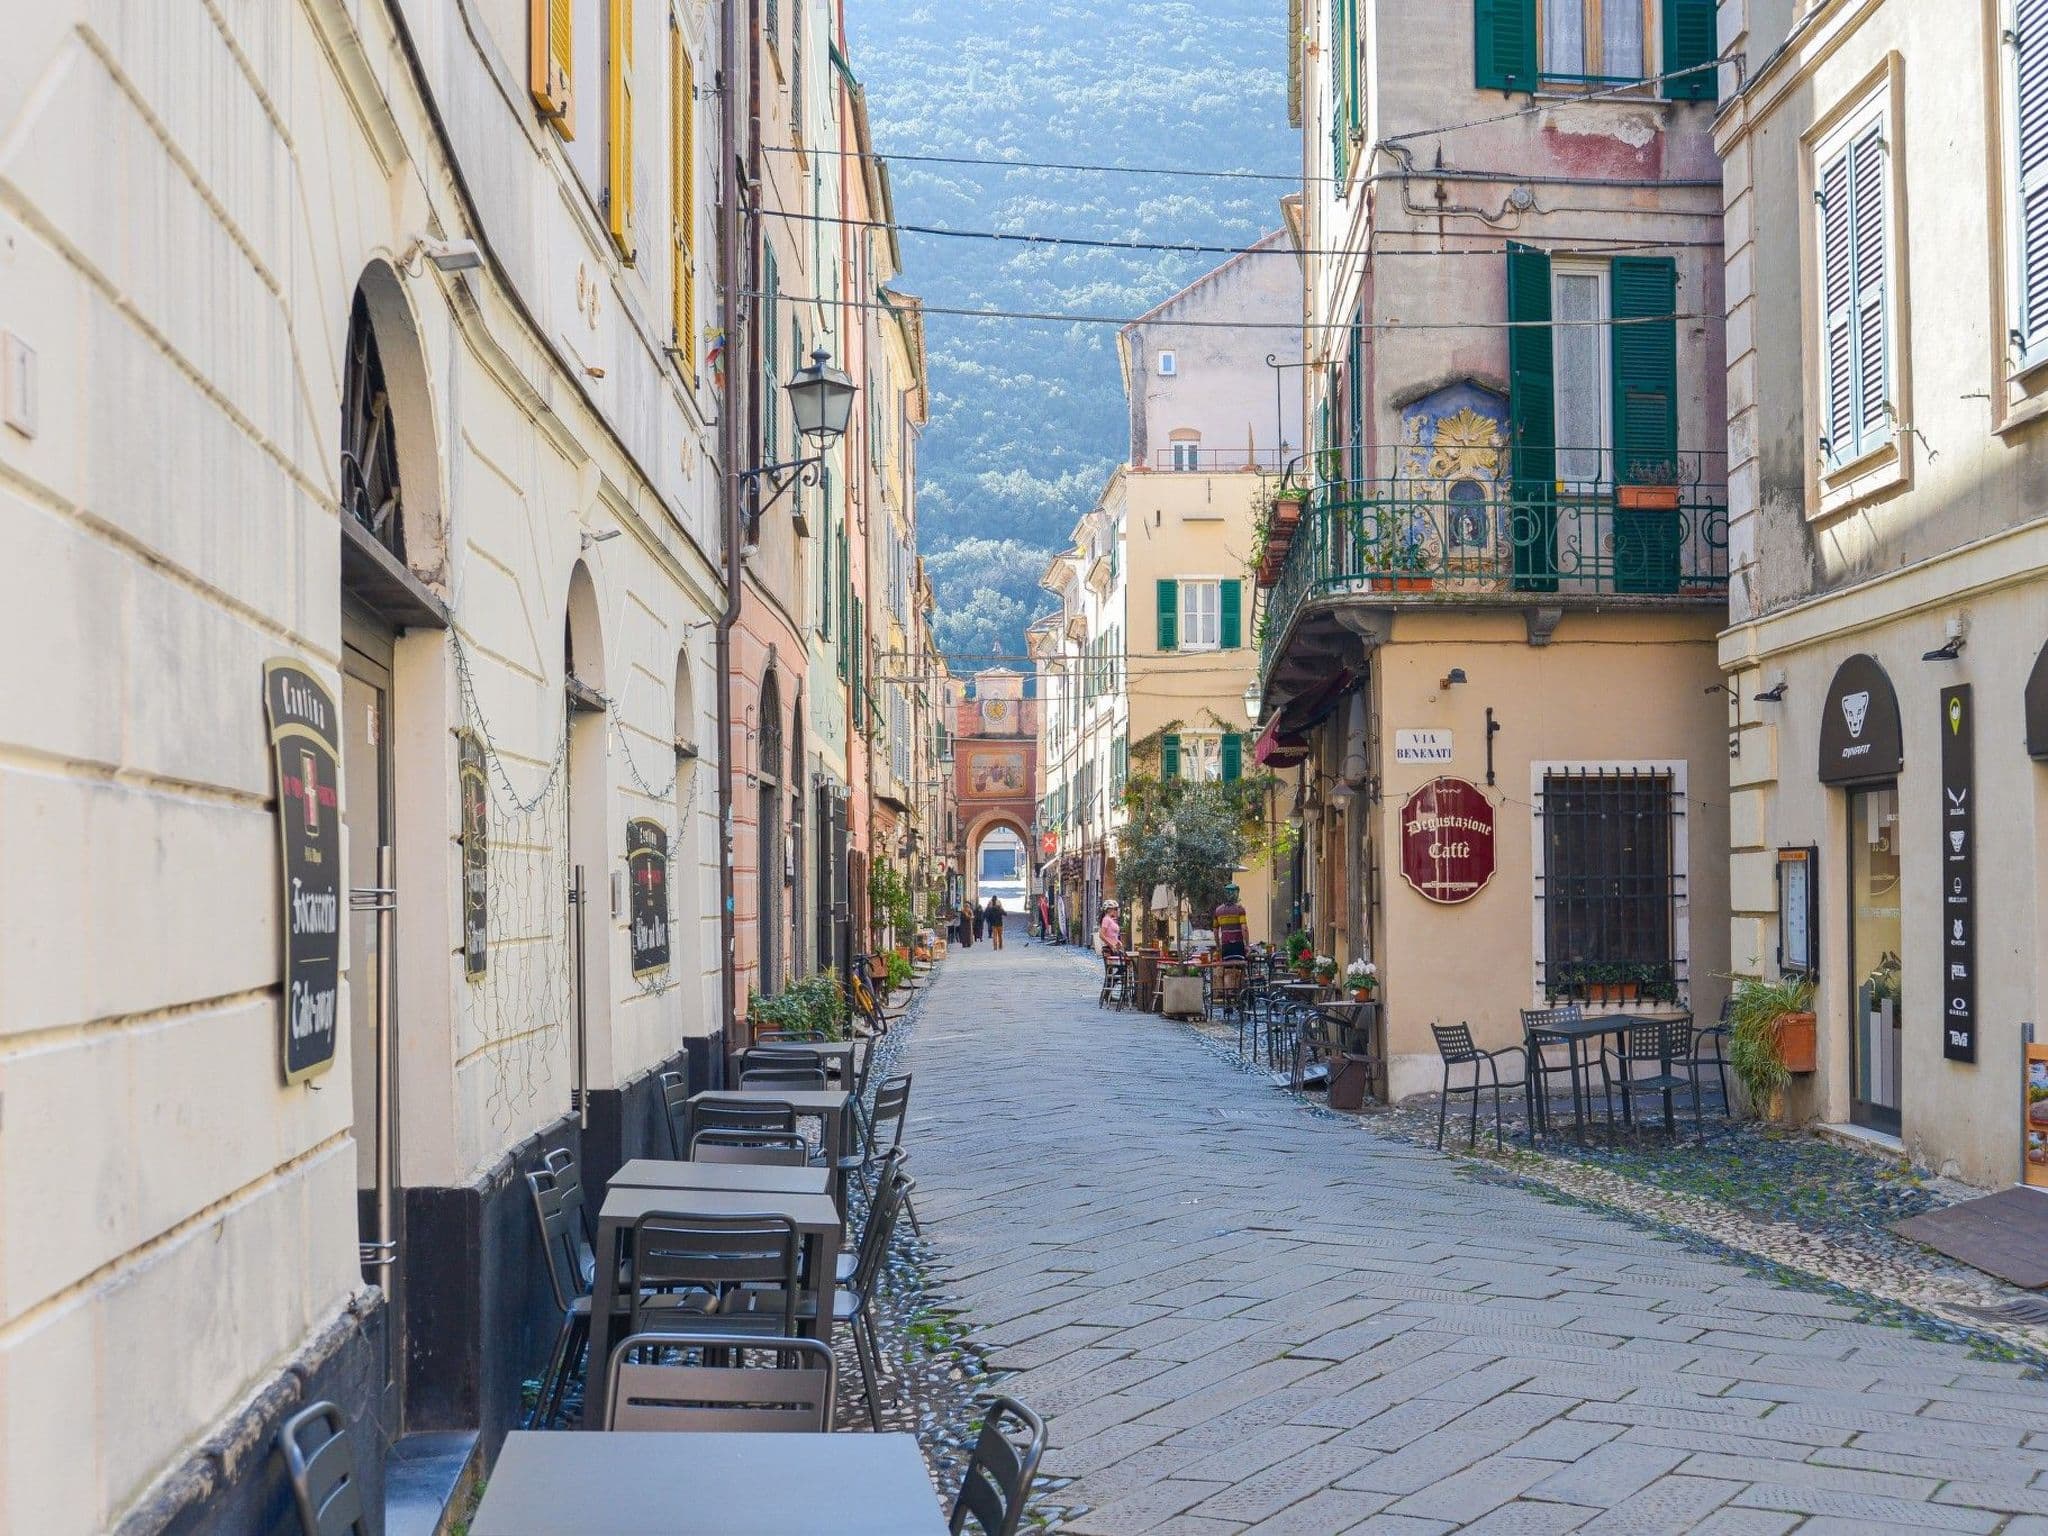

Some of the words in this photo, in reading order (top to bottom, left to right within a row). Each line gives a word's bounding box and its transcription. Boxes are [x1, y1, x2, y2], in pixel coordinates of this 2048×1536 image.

[1412, 734, 1436, 744] VIA
[1396, 748, 1452, 759] BENENATI
[1405, 814, 1492, 837] Degustazione
[1428, 841, 1471, 859] Caffè
